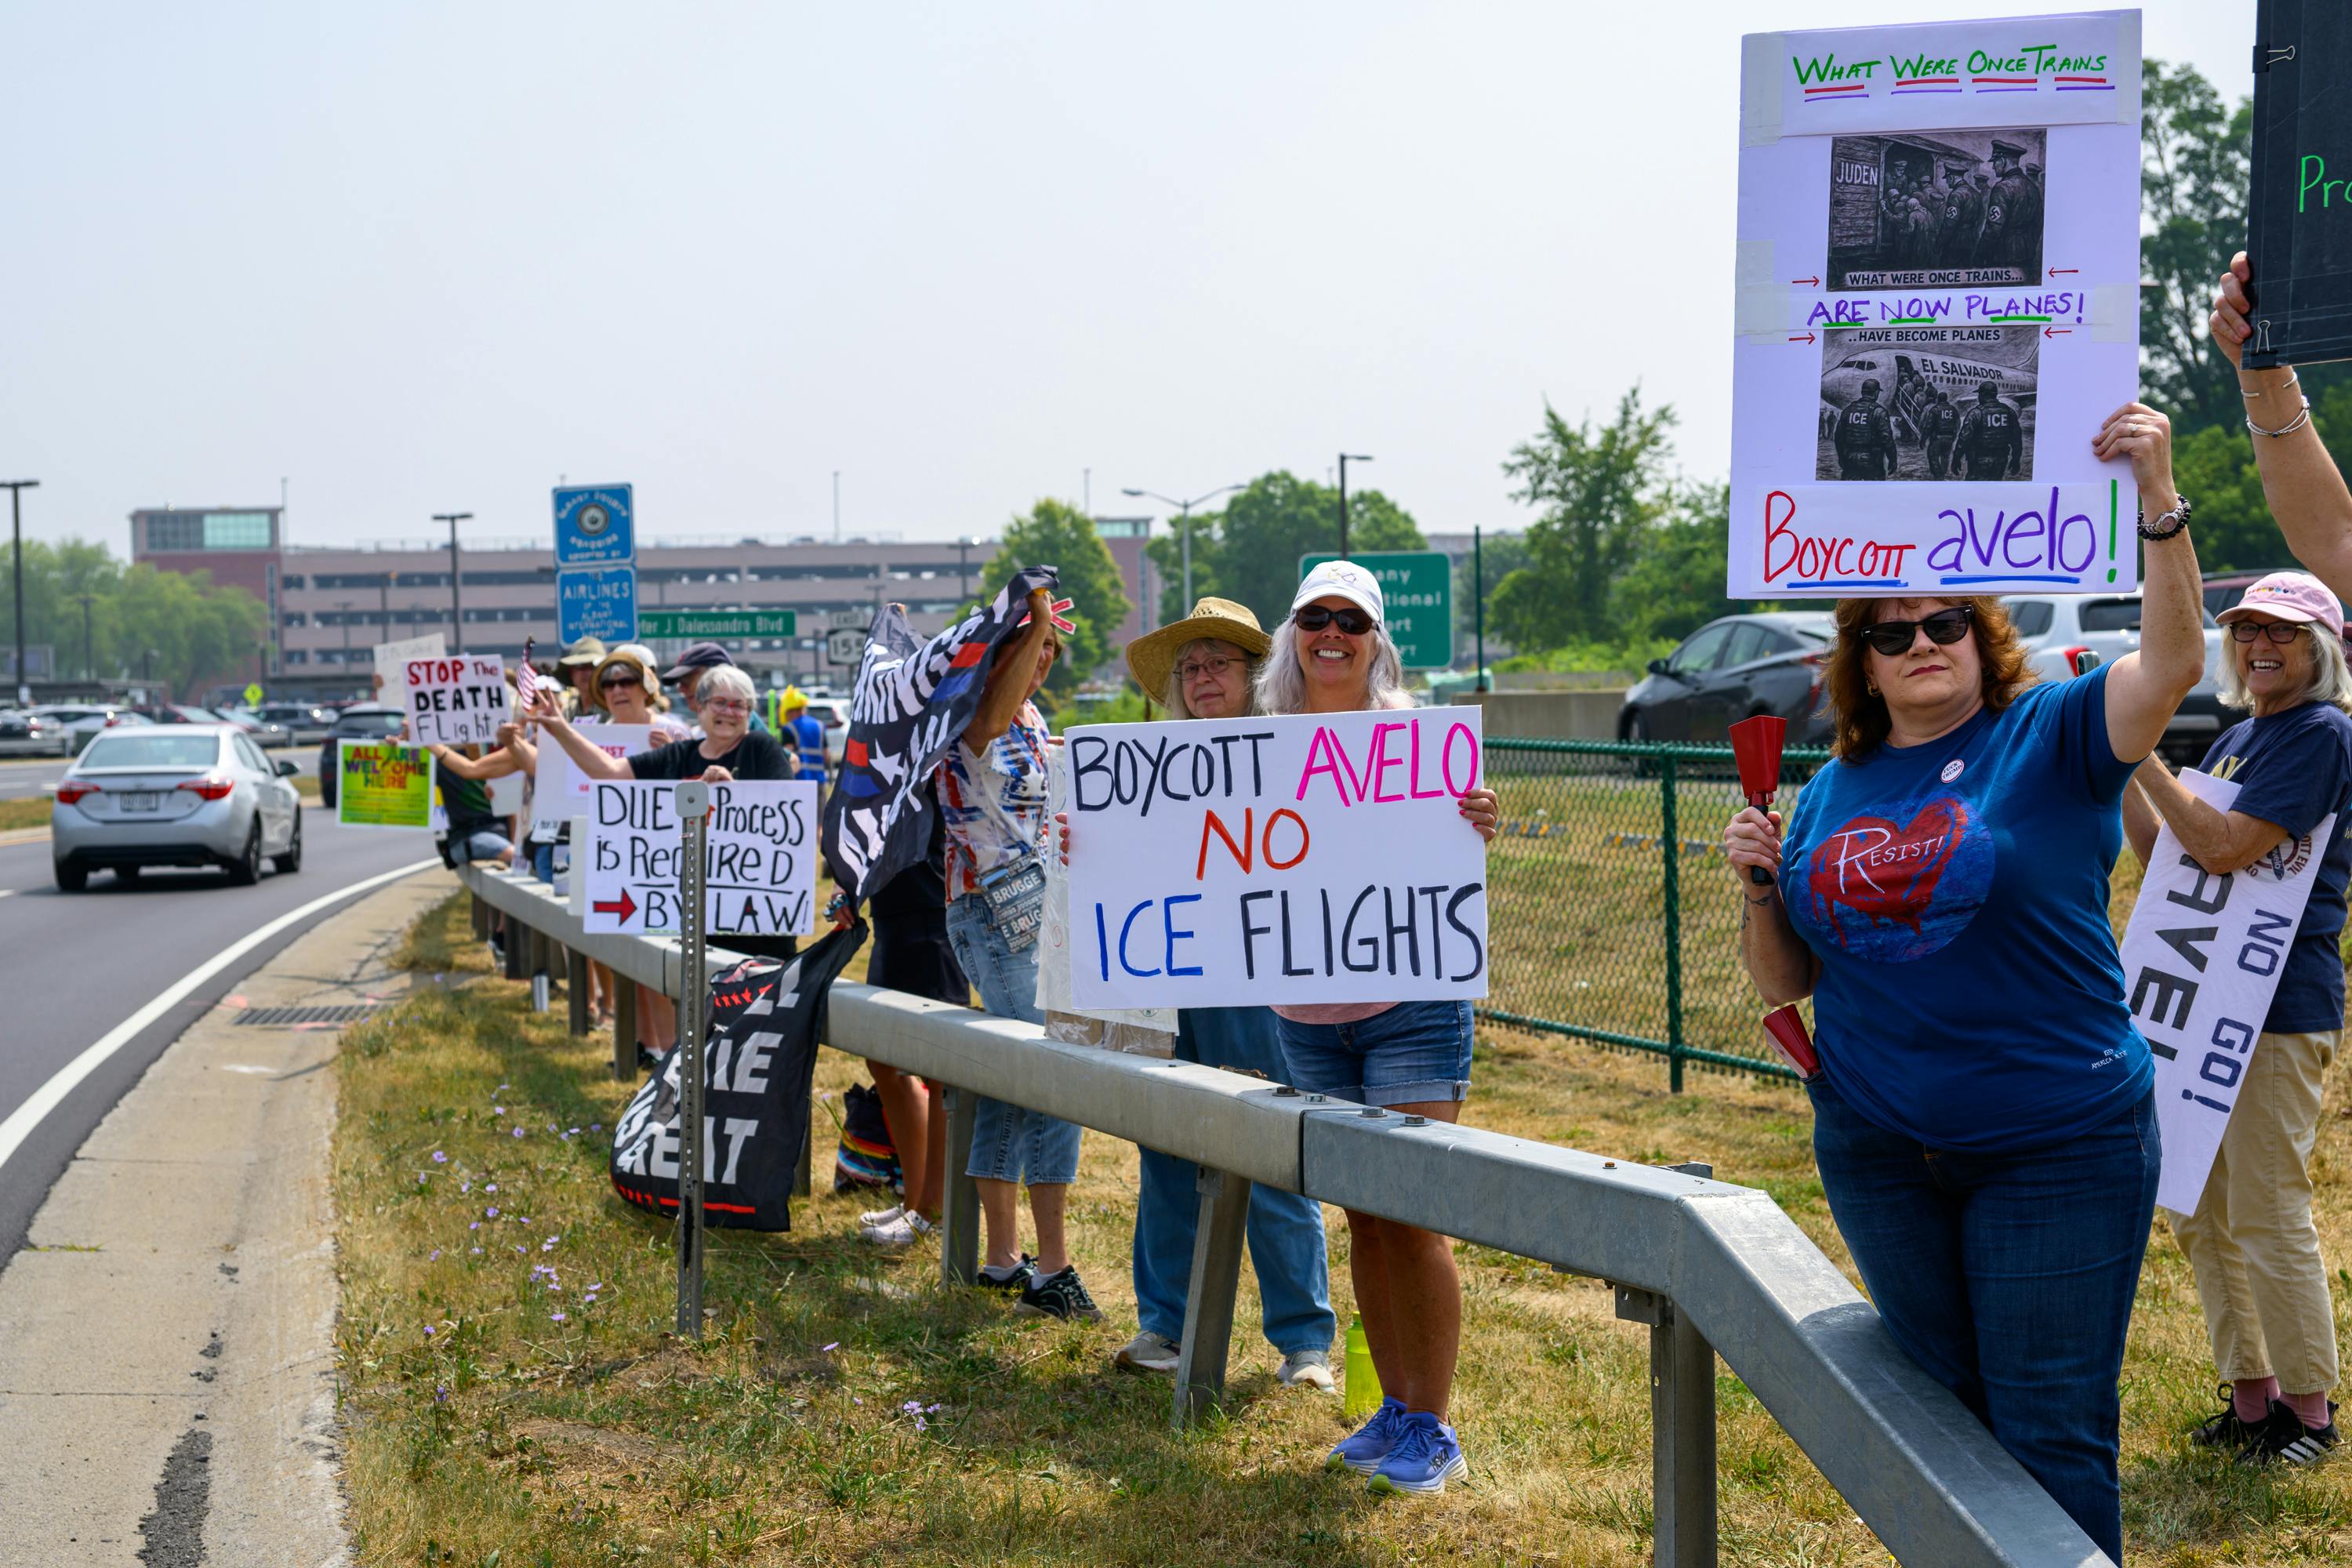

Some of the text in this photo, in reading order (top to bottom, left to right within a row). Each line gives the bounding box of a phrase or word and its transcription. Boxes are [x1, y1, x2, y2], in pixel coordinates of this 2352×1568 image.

[1792, 44, 2107, 85] WHAT WERE ONCE TRAINS
[1835, 161, 1878, 186] JUDEN
[1849, 270, 2024, 286] WHAT WERE ONCE TRAINS...
[1806, 292, 2085, 327] ARE NOW PLANES!
[1896, 329, 1947, 342] BECOME
[1951, 328, 2001, 342] PLANES
[1921, 358, 2004, 381] EL SALVADOR
[1848, 412, 1867, 425] ICE
[1940, 409, 1954, 420] ICE
[1987, 413, 2008, 427] ICE
[564, 582, 630, 600] AIRLINES
[664, 617, 672, 634] J
[677, 616, 750, 633] Dalessandro
[756, 615, 784, 633] Blvd
[407, 659, 465, 686] STOP
[472, 661, 499, 677] The
[414, 686, 504, 712] DEATH
[352, 747, 382, 760] ALL
[345, 760, 427, 776] WELCOME
[1071, 731, 1275, 817] BOYCOTT
[1296, 718, 1479, 808] AVELO
[1943, 765, 1962, 779] TRUMP
[1944, 762, 1958, 774] FUCK
[364, 775, 407, 789] HERE
[597, 784, 804, 847] DUE Process
[595, 835, 621, 872] is
[1196, 807, 1311, 880] NO
[2287, 855, 2309, 876] EVIL
[992, 872, 1041, 904] BRUGGE
[1095, 882, 1483, 982] ICE FLIGHTS
[2180, 908, 2293, 1114] NO GO!
[2103, 1048, 2114, 1057] KEEP
[2091, 1057, 2114, 1070] AMERICA
[1428, 1447, 1450, 1472] HOKA
